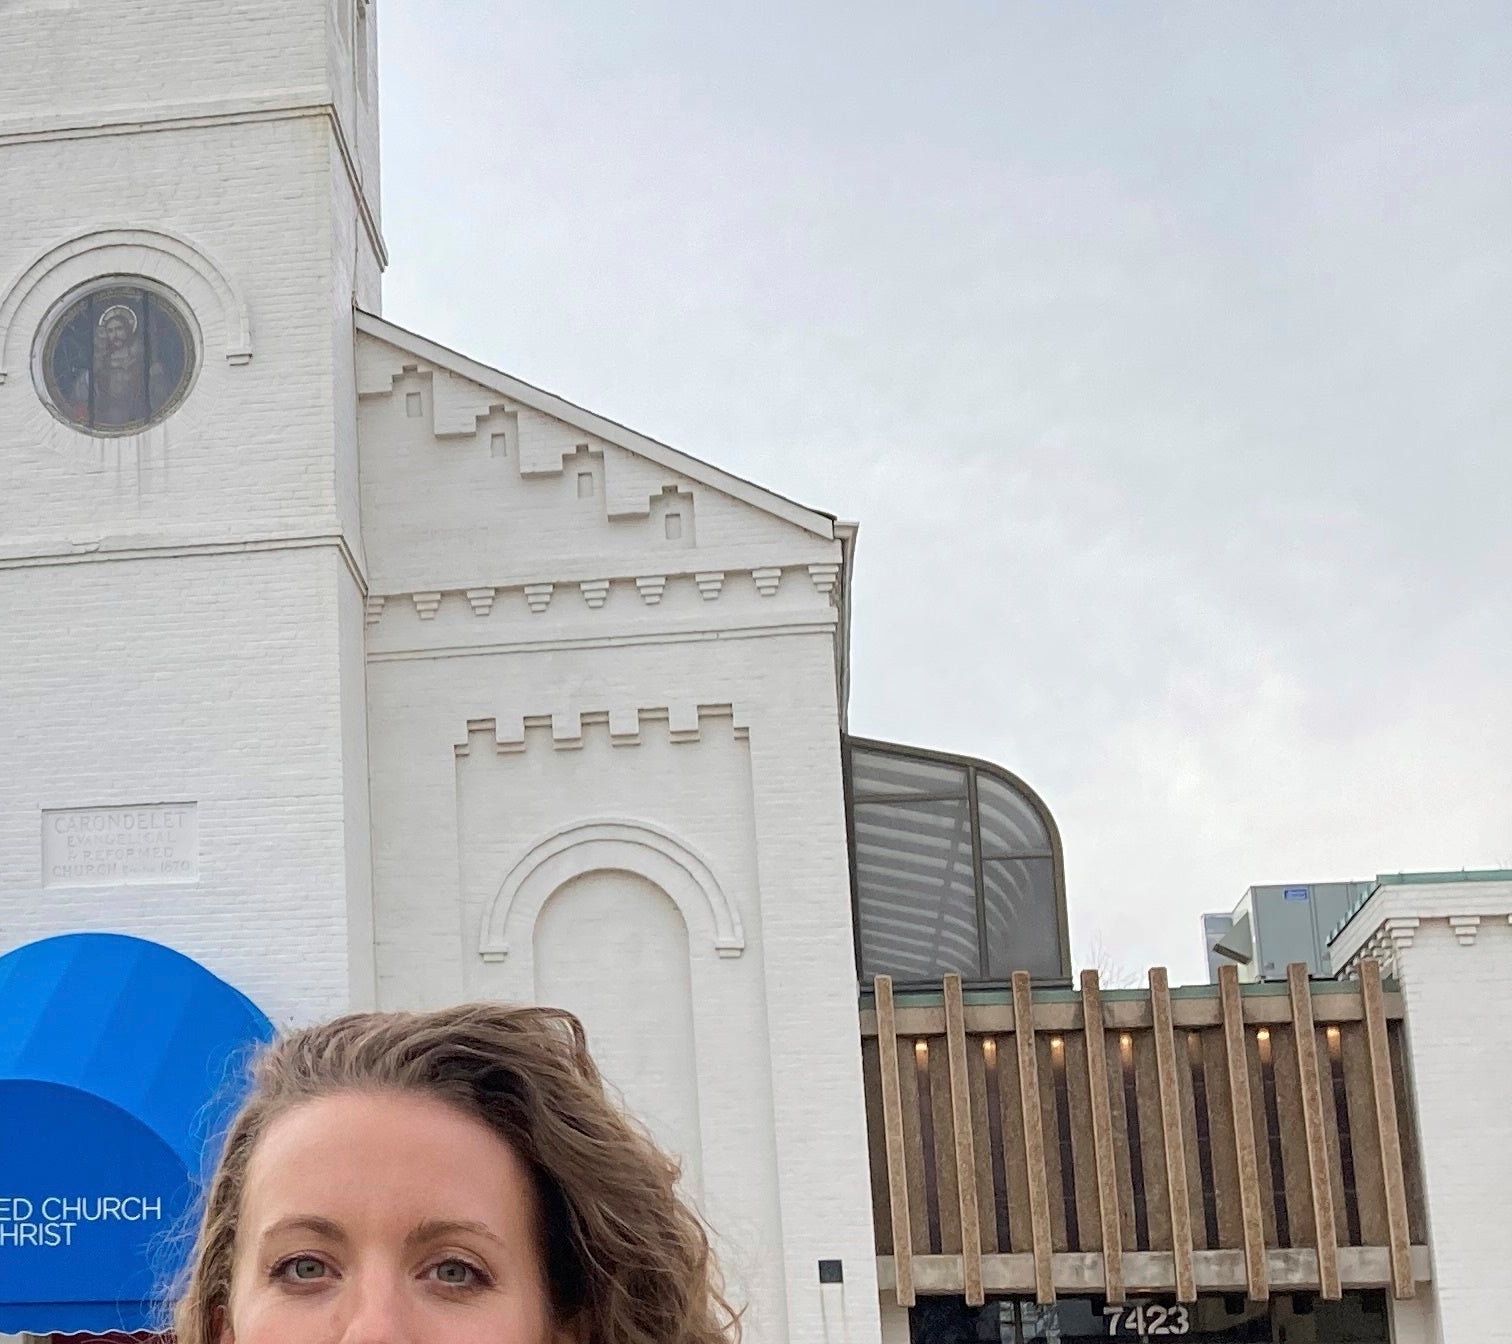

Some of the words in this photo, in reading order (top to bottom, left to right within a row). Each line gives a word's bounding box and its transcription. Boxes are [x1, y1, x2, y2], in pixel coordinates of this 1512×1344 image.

[54, 811, 187, 834] CARONDELET
[67, 830, 177, 847] EVANGELICAL
[82, 846, 174, 862] REFORMED
[52, 862, 117, 878] CHURCH
[41, 1196, 161, 1221] CHURCH
[1103, 1304, 1190, 1336] 7423
